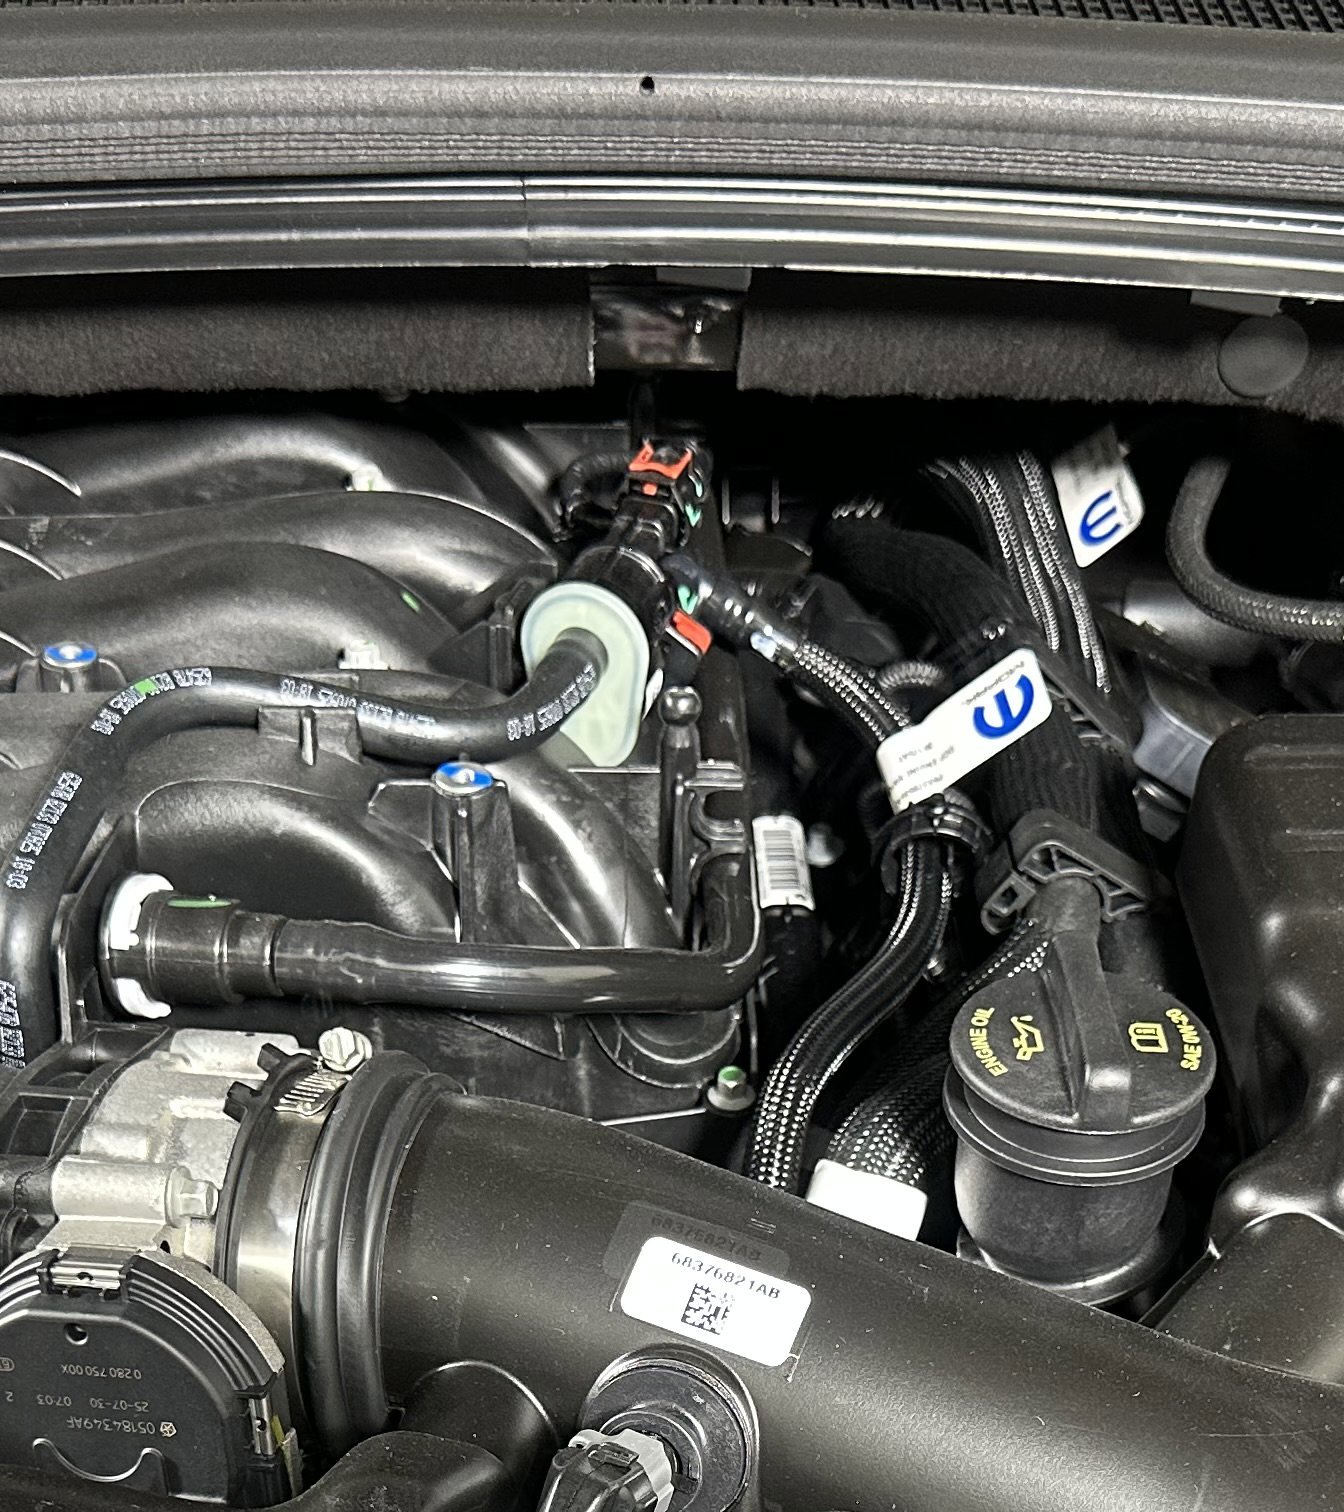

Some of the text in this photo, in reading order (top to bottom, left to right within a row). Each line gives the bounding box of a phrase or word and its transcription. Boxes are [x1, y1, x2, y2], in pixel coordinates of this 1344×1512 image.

[969, 1007, 1008, 1077] ENGINE OIL
[1165, 1008, 1202, 1071] SAE 0W-20
[671, 1252, 781, 1299] 68376821AB
[66, 1416, 156, 1435] 05184349AF
[90, 1397, 149, 1413] 25-07-30
